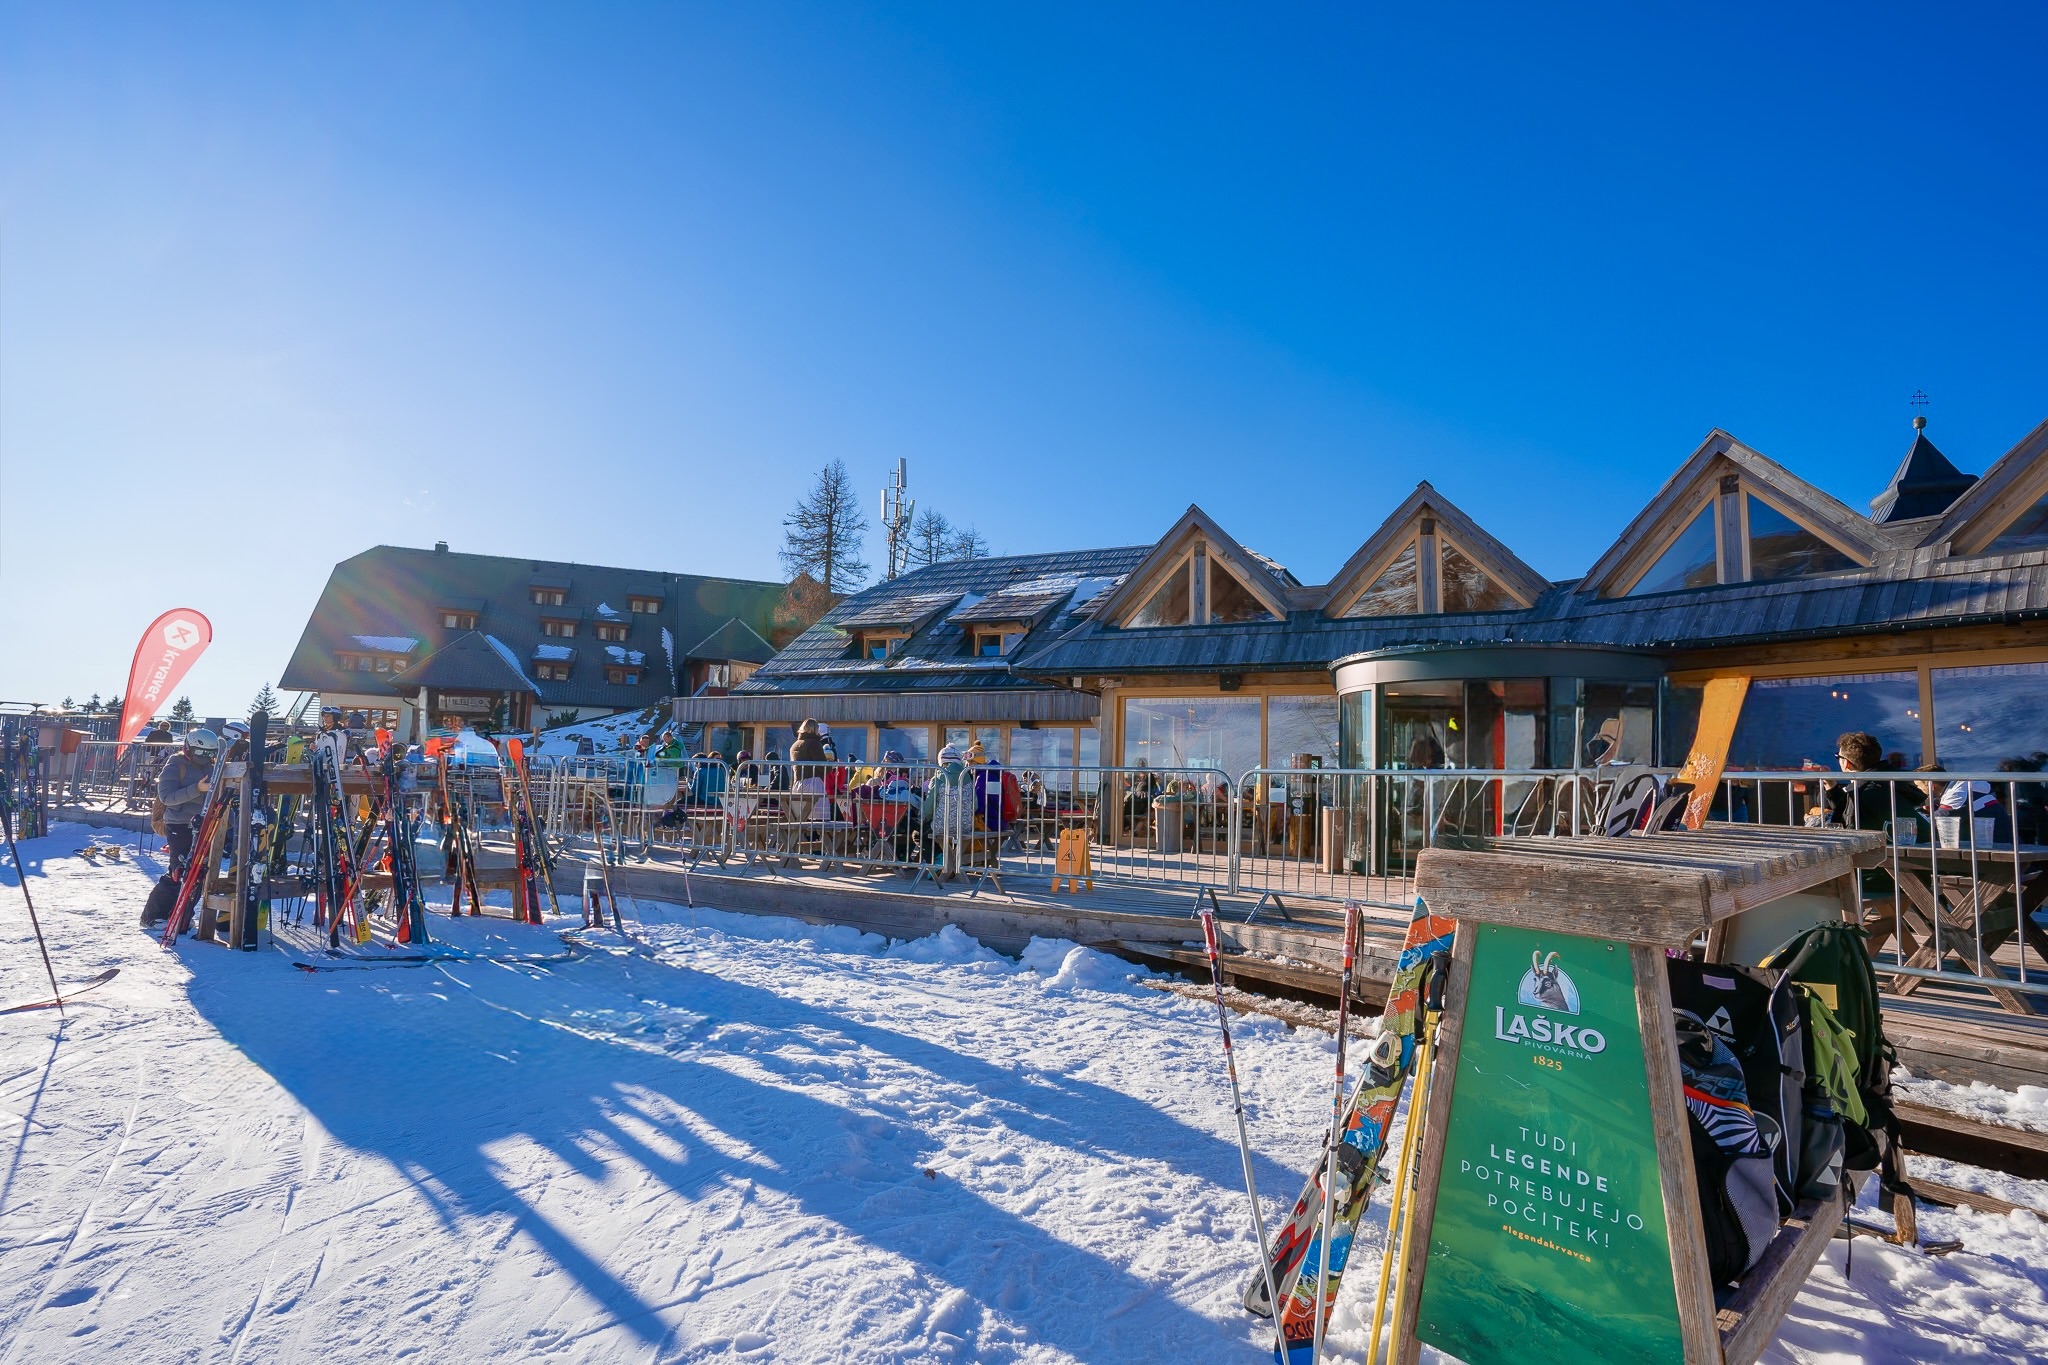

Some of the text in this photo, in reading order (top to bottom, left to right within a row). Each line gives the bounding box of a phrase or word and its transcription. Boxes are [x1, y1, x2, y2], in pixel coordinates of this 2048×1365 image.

[144, 649, 180, 702] krvavec
[324, 745, 339, 794] HEAD
[1495, 1005, 1607, 1054] LAŠKO
[1524, 1040, 1592, 1061] PIVOVARNA
[1533, 1055, 1562, 1071] 1825
[1519, 1126, 1576, 1156] TUDI
[1490, 1144, 1608, 1193] LEGENDE
[1461, 1160, 1643, 1231] POTREBUJEJO
[1488, 1194, 1609, 1248] POČITEK!
[1502, 1224, 1591, 1263] #legendakrvavca
